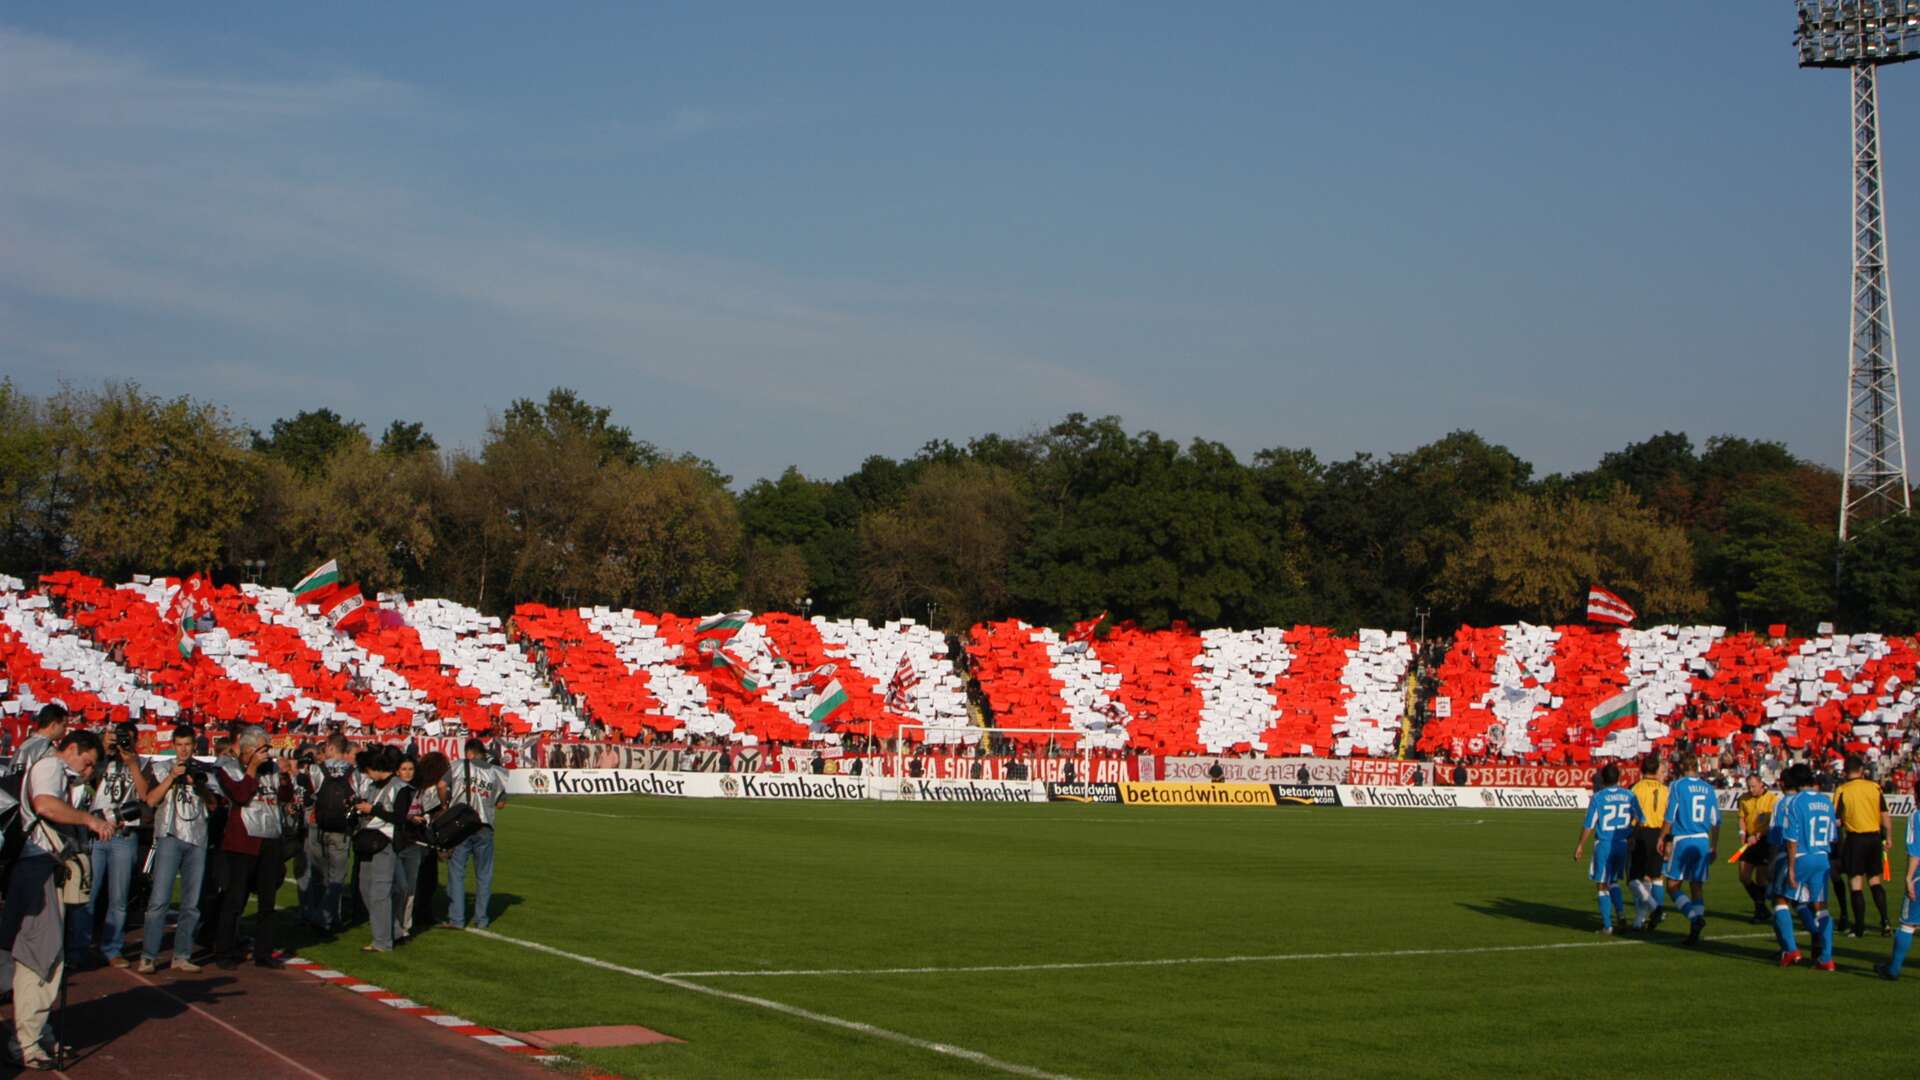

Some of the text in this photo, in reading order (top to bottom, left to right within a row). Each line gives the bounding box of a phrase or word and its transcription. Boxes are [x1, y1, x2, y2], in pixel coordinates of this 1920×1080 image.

[1351, 760, 1399, 773] REDS
[554, 771, 685, 795] Krombacher
[741, 775, 865, 799] Krombacher
[918, 780, 1032, 802] Krombacher
[1127, 785, 1270, 804] betandwin.com
[1279, 785, 1334, 797] betandwin
[1366, 787, 1459, 807] Krombacher
[1495, 789, 1579, 808] Krombacher
[1652, 788, 1660, 812] 1
[1691, 795, 1706, 822] 6
[1602, 803, 1631, 831] 25
[1809, 816, 1831, 847] 13
